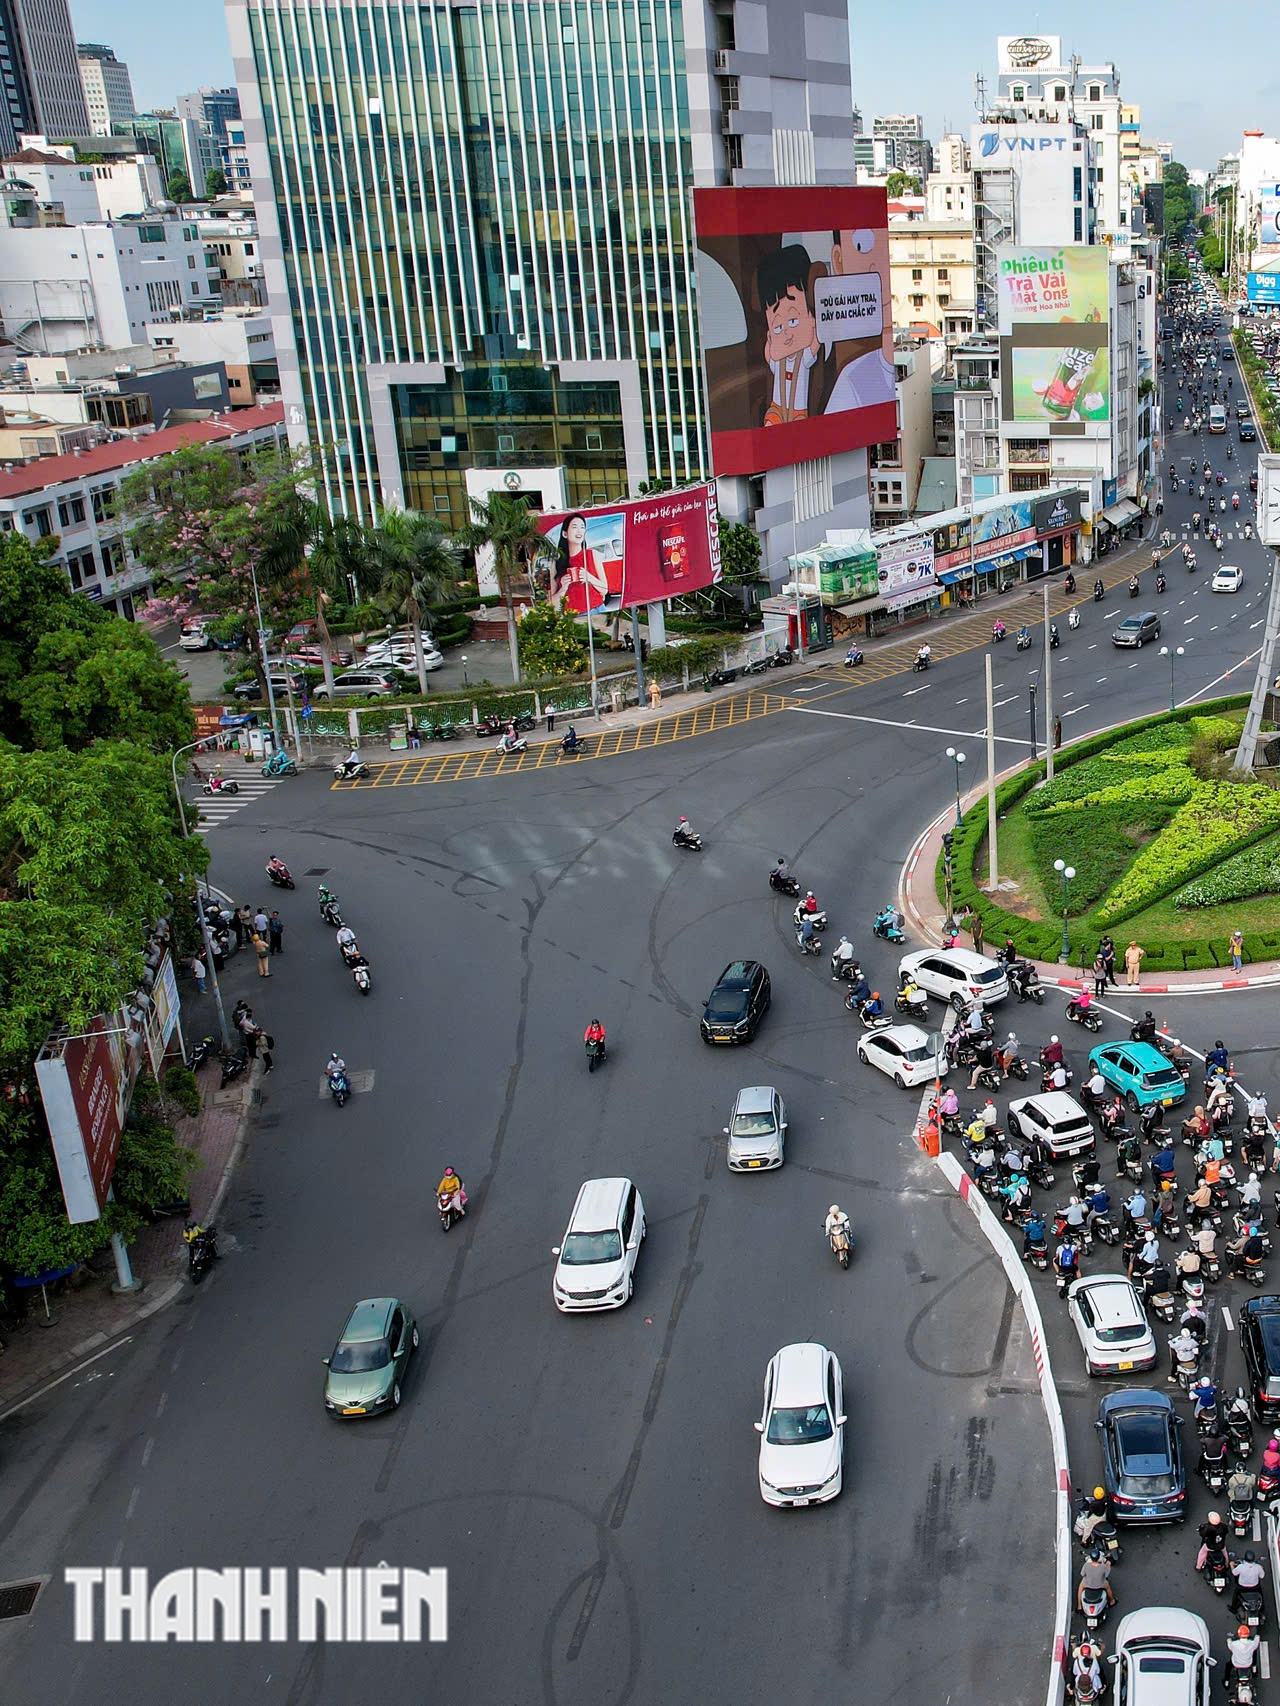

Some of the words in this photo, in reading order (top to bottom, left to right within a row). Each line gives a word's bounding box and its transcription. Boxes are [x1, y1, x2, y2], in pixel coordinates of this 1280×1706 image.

[1003, 137, 1067, 151] VNPT
[1001, 255, 1048, 275] Phiêu
[1006, 275, 1033, 293] Trà
[847, 295, 860, 305] HAY
[1043, 288, 1069, 303] Ong
[1039, 303, 1053, 311] Hoa
[922, 539, 932, 552] 7K
[918, 563, 932, 579] 7K
